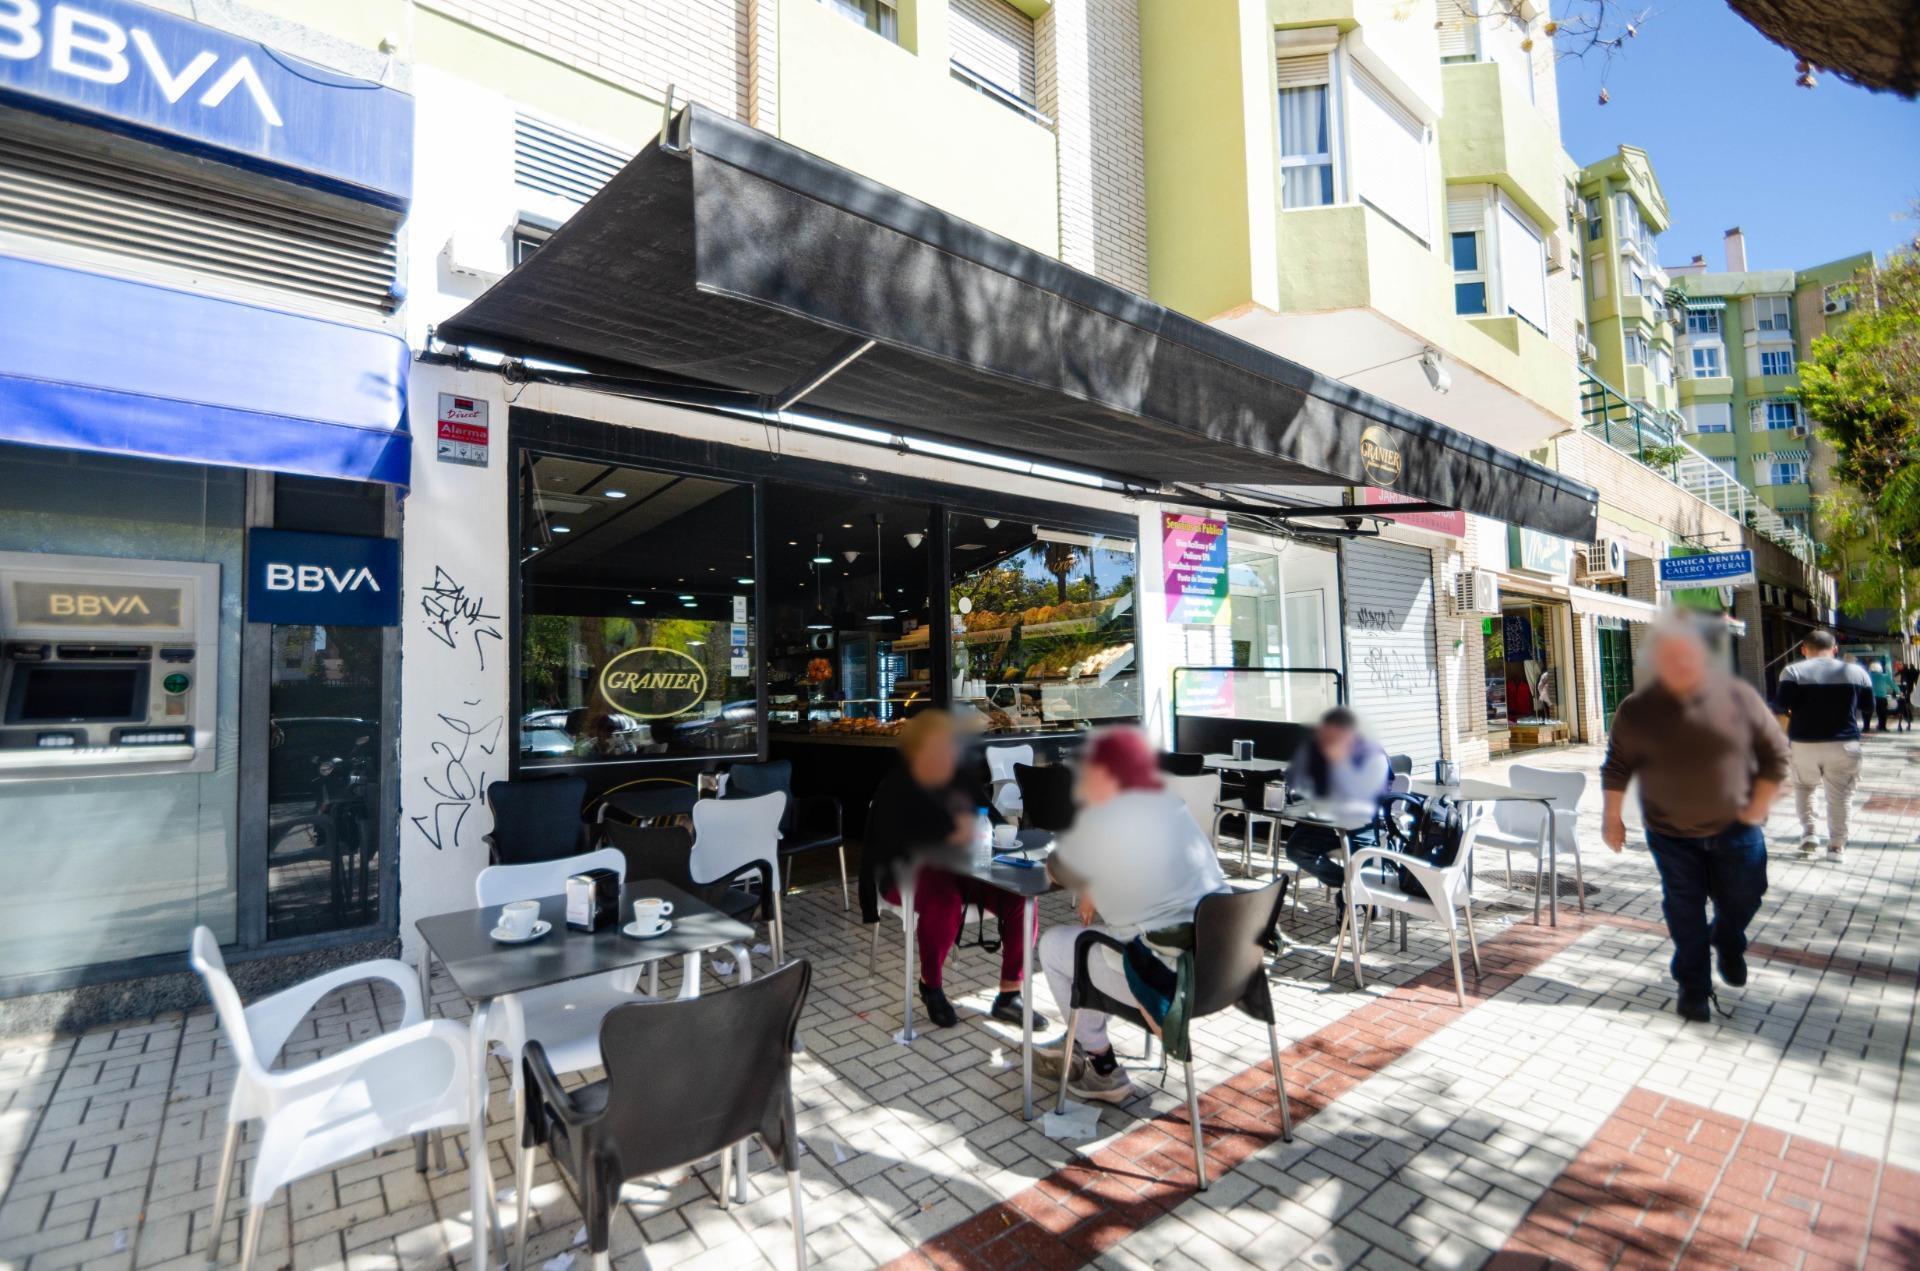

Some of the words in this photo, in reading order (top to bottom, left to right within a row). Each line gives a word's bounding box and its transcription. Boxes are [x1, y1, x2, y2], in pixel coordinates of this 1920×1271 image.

[441, 423, 486, 437] Alarma
[1361, 441, 1400, 470] GRANIER
[1665, 558, 1705, 567] CLINICA
[1708, 554, 1746, 563] DENTAL
[1665, 565, 1705, 575] CALERO
[1716, 561, 1746, 570] PERAL
[266, 564, 381, 593] BBVA
[50, 594, 150, 616] BBVA
[608, 671, 700, 693] GRANIER
